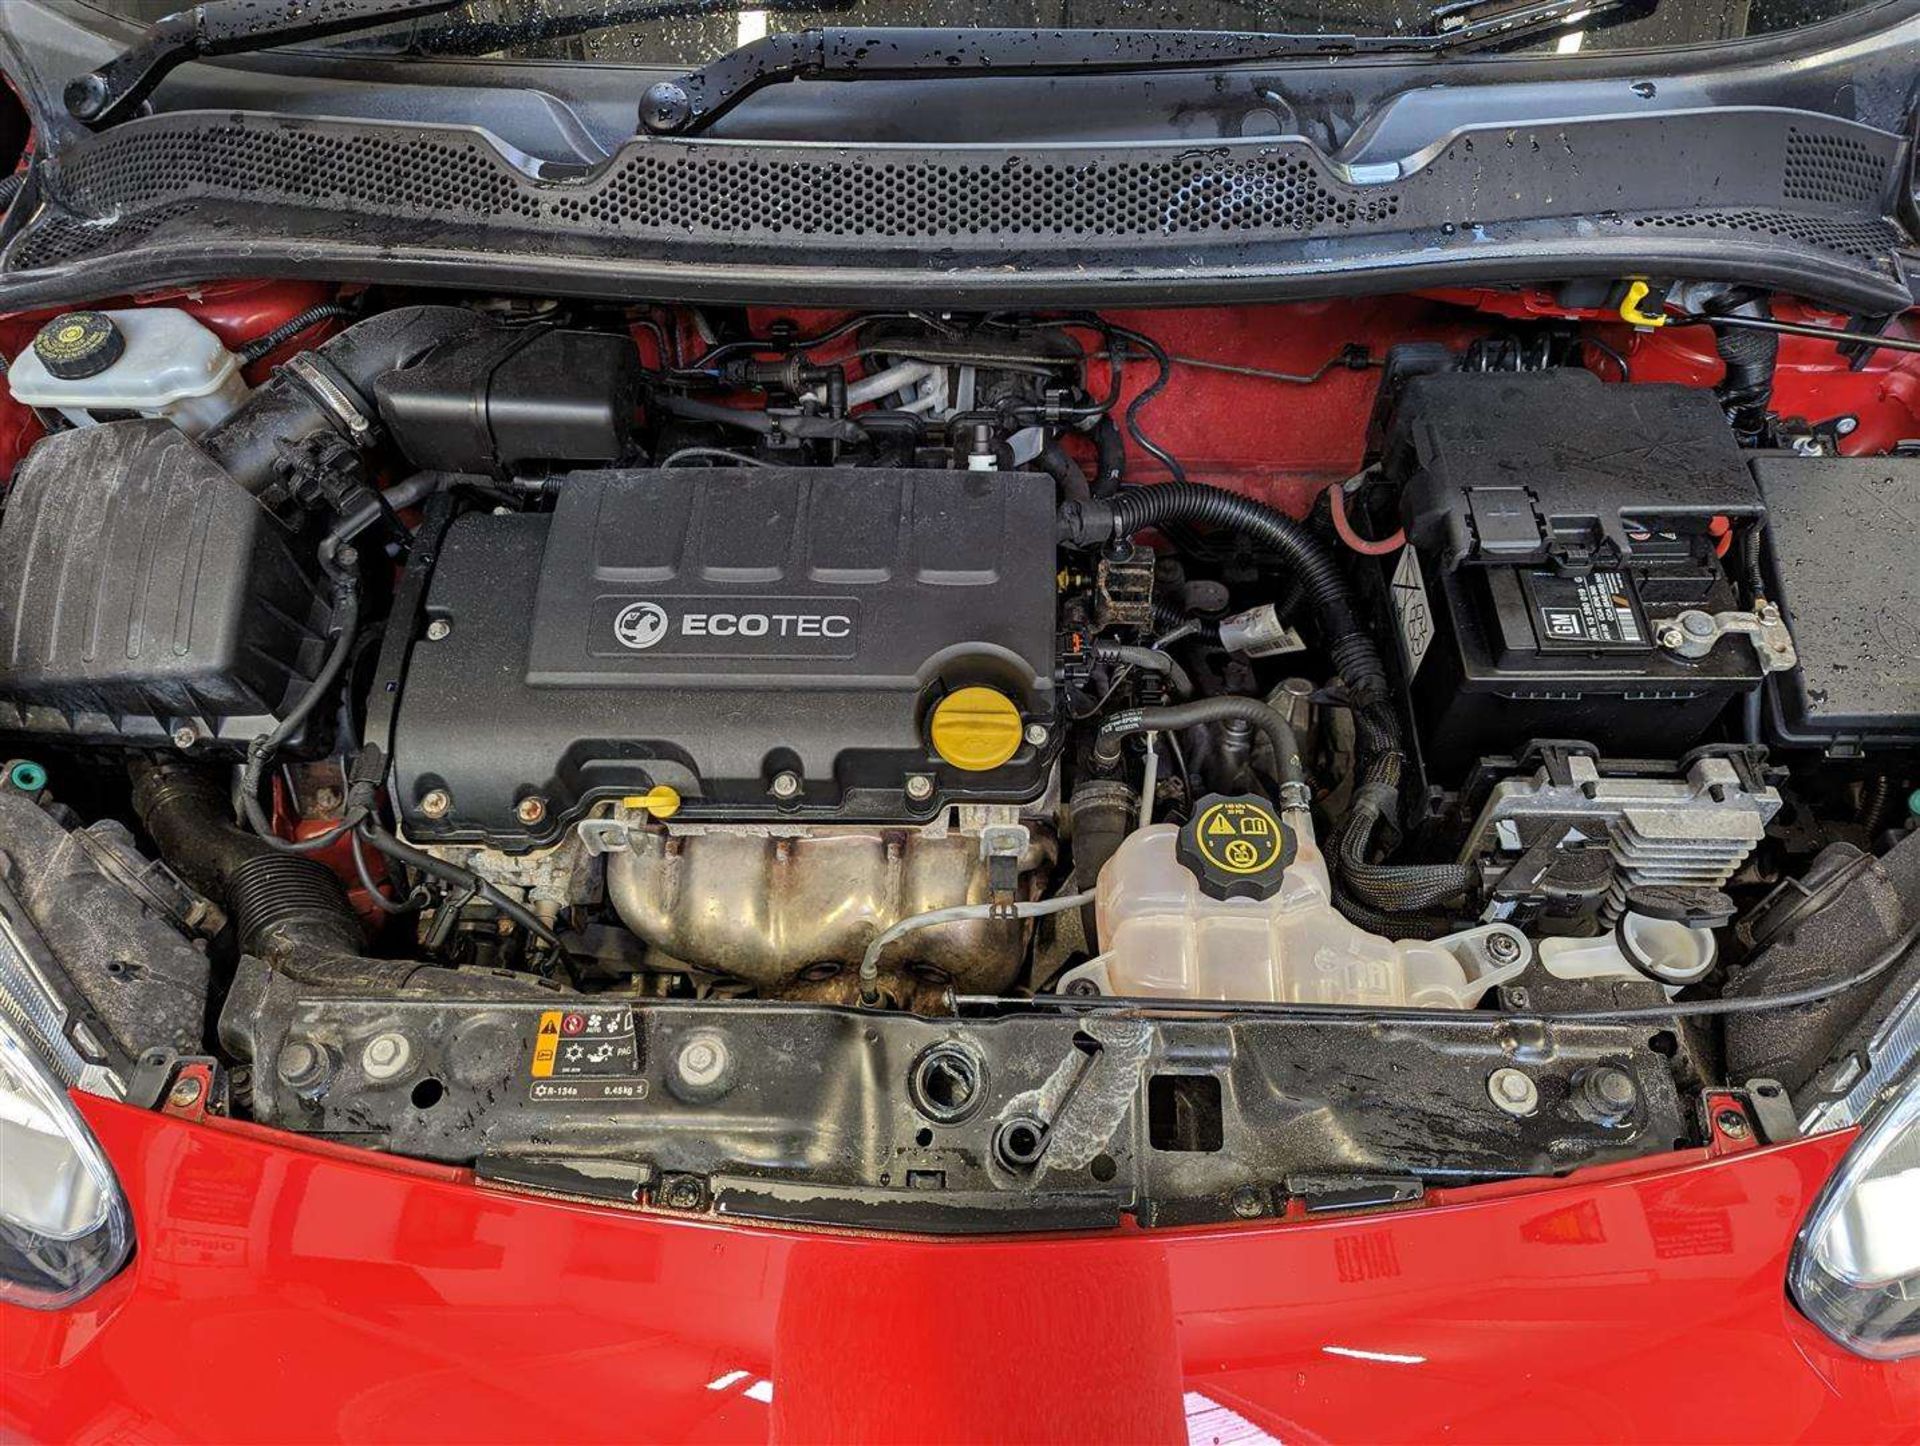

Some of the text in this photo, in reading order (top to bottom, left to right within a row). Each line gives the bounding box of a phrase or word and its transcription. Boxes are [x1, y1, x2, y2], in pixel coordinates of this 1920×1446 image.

[681, 613, 851, 637] ECOTEC
[1550, 614, 1574, 634] GM
[617, 1046, 631, 1056] PAG
[547, 1086, 578, 1096] R-134a
